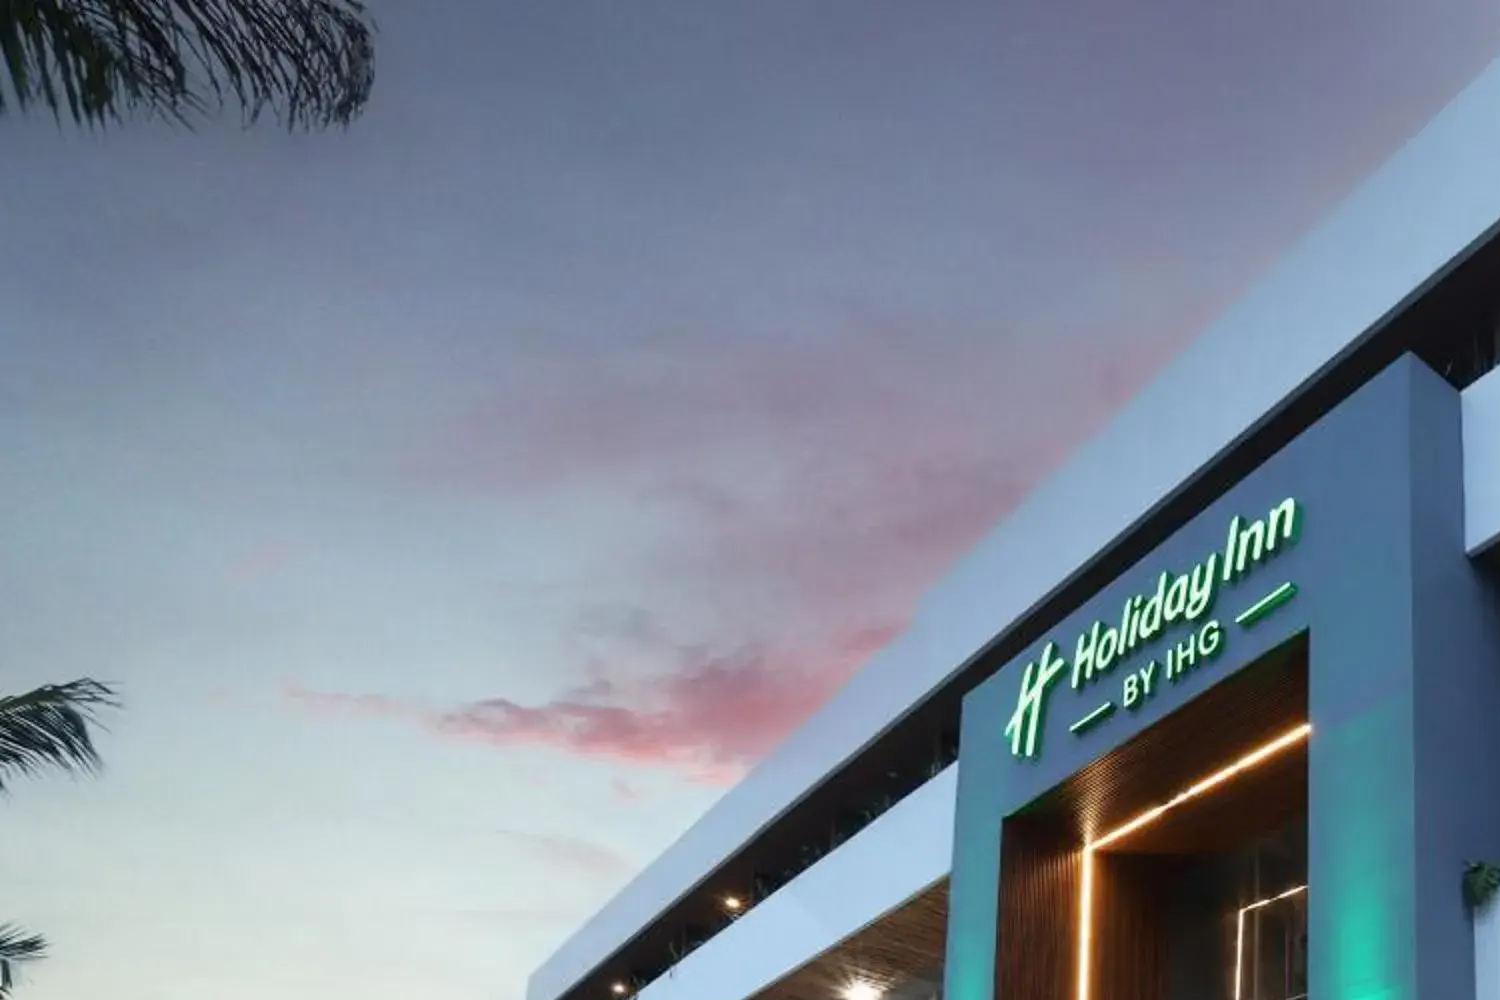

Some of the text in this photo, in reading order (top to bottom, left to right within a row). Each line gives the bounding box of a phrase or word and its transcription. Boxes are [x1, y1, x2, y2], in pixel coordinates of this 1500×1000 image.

[1070, 497, 1297, 689] Holiday Inn
[1122, 620, 1221, 709] BY IHG
